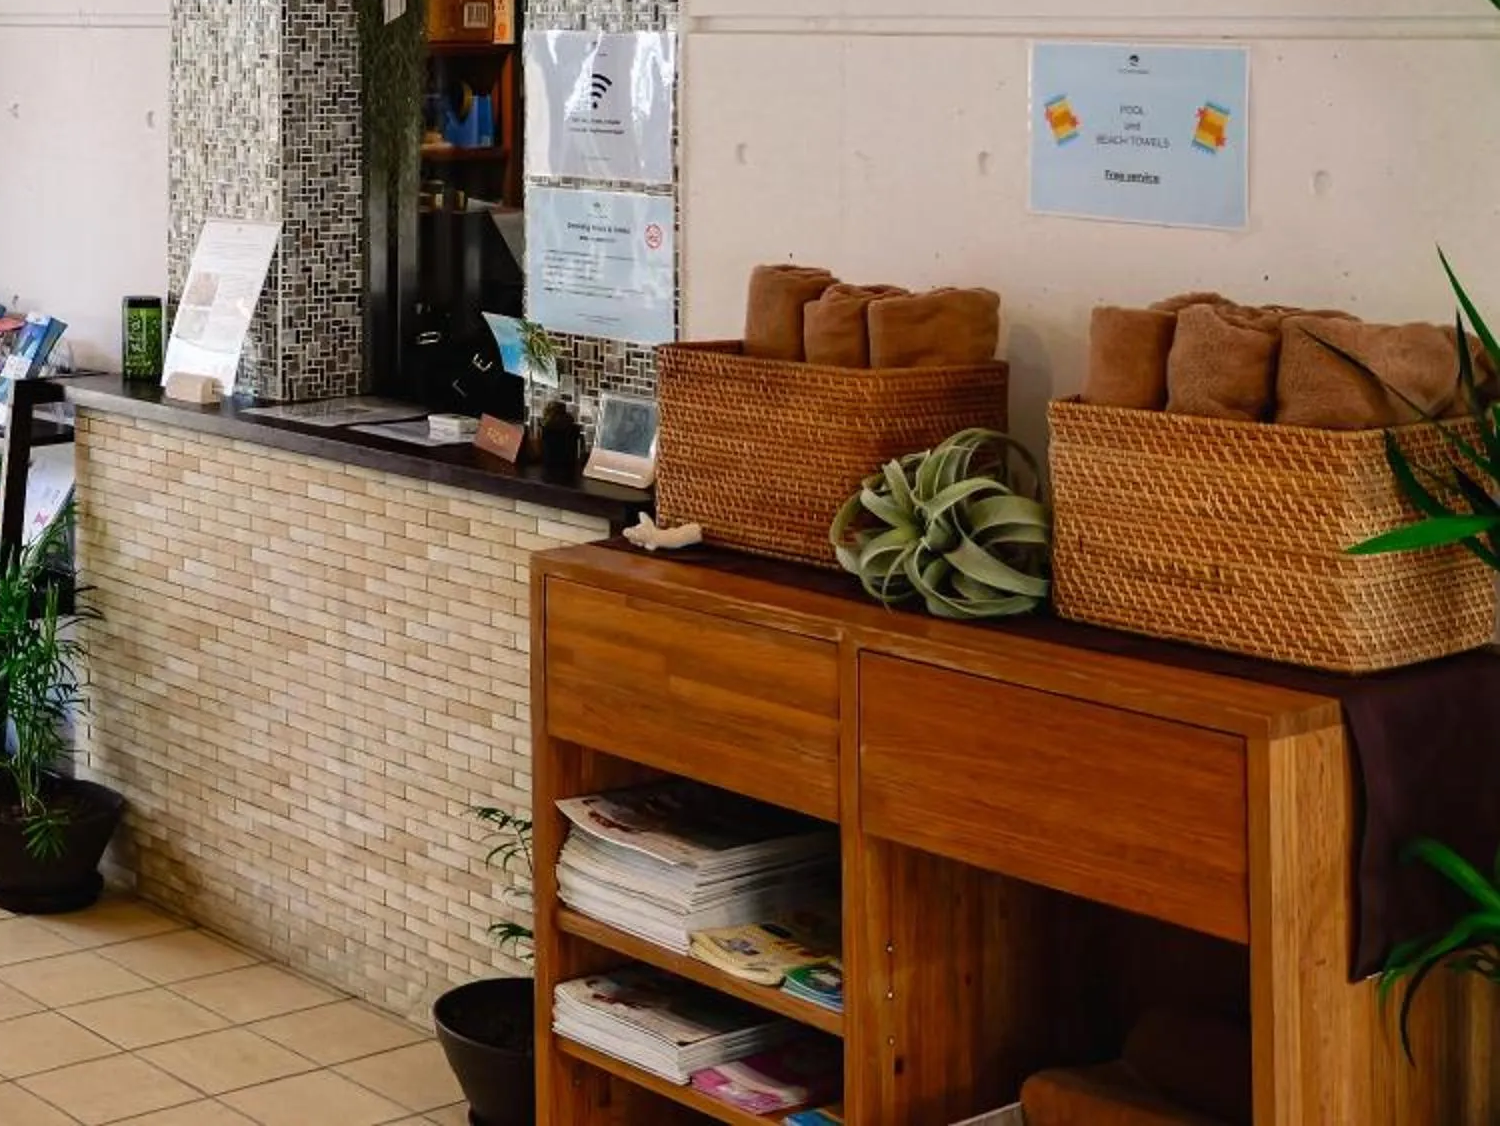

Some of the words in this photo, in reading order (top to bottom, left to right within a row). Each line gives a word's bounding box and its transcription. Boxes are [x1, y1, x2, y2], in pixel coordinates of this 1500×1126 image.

[1120, 105, 1144, 115] POOL
[1096, 135, 1128, 145] BEACH
[1129, 135, 1171, 149] TOWELS
